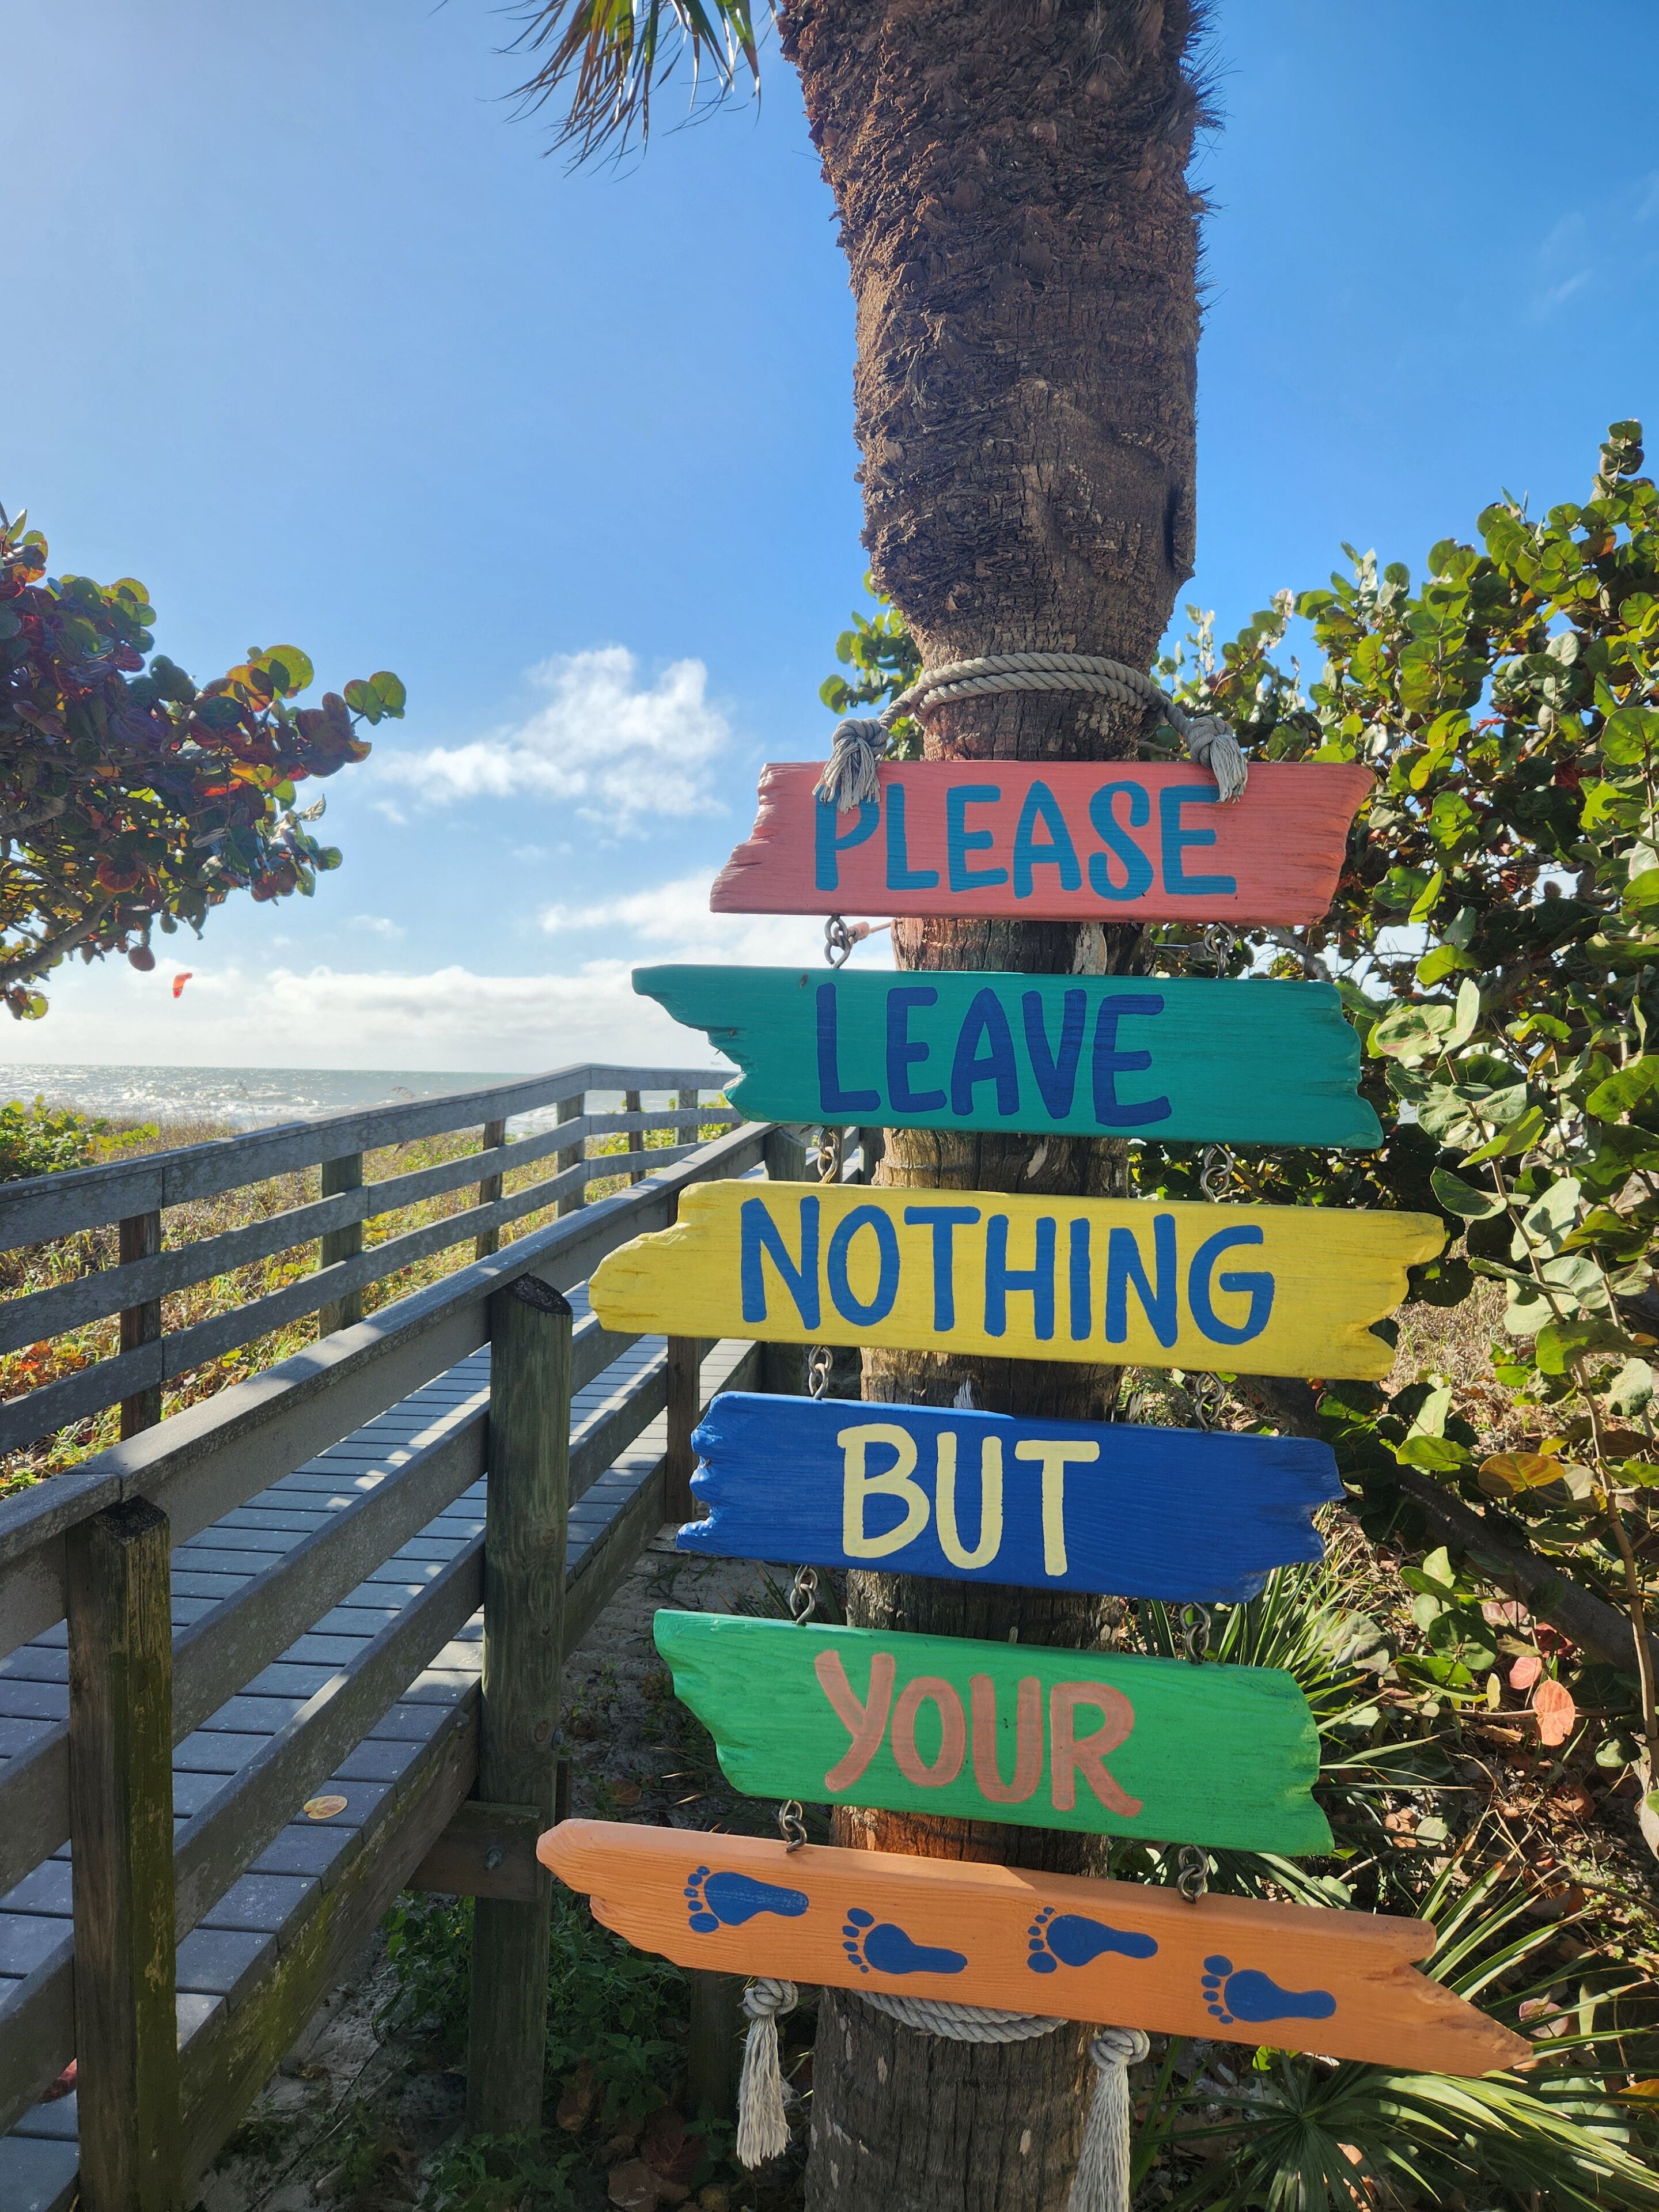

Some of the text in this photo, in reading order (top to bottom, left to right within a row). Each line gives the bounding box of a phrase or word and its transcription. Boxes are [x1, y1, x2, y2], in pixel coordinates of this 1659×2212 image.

[815, 779, 1237, 901] PLEASE
[816, 982, 1172, 1127] LEAVE
[740, 1195, 1275, 1348] NOTHING
[836, 1423, 1100, 1575] BUT
[814, 1649, 1143, 1817] YOUR
